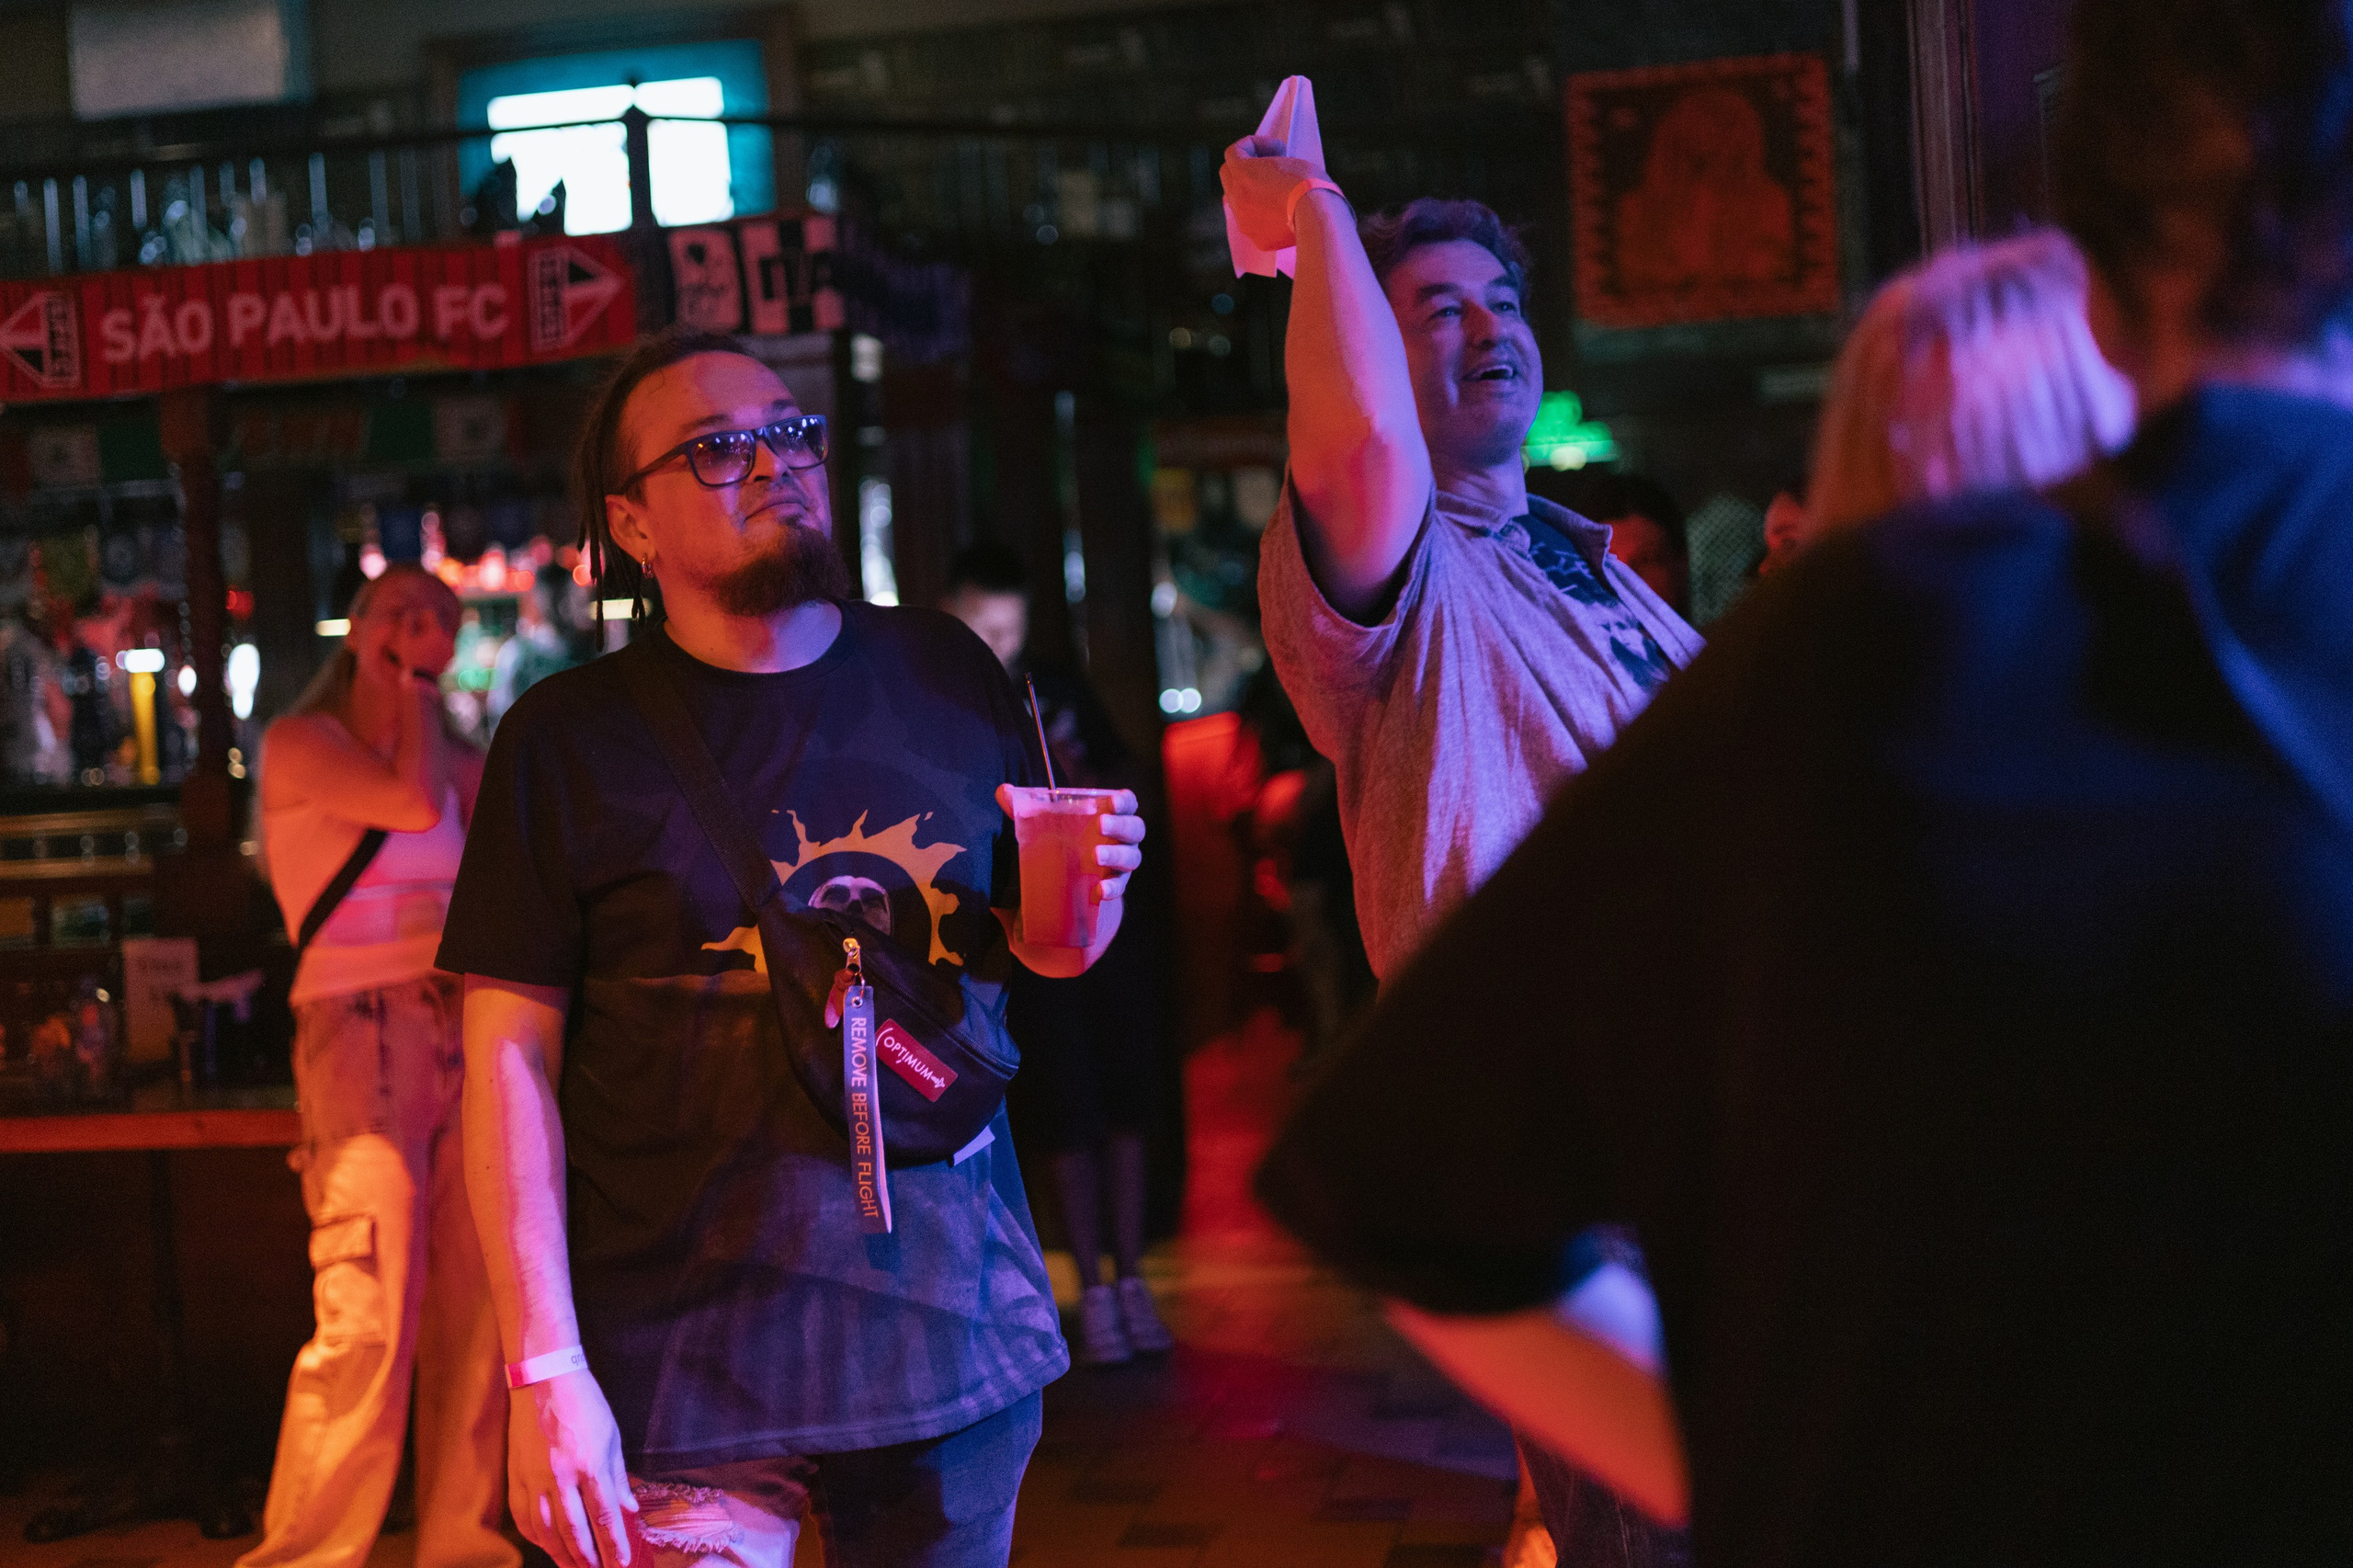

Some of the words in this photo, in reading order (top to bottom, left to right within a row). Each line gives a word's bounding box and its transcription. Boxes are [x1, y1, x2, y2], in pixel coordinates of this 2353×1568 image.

[101, 293, 212, 362] SÃO
[228, 283, 419, 347] PAULO
[433, 282, 507, 341] FC
[850, 1017, 867, 1087] REMOVE
[883, 1036, 934, 1081] OPTIMUM
[851, 1093, 871, 1155] BEFORE
[858, 1162, 879, 1218] FLIGHT
